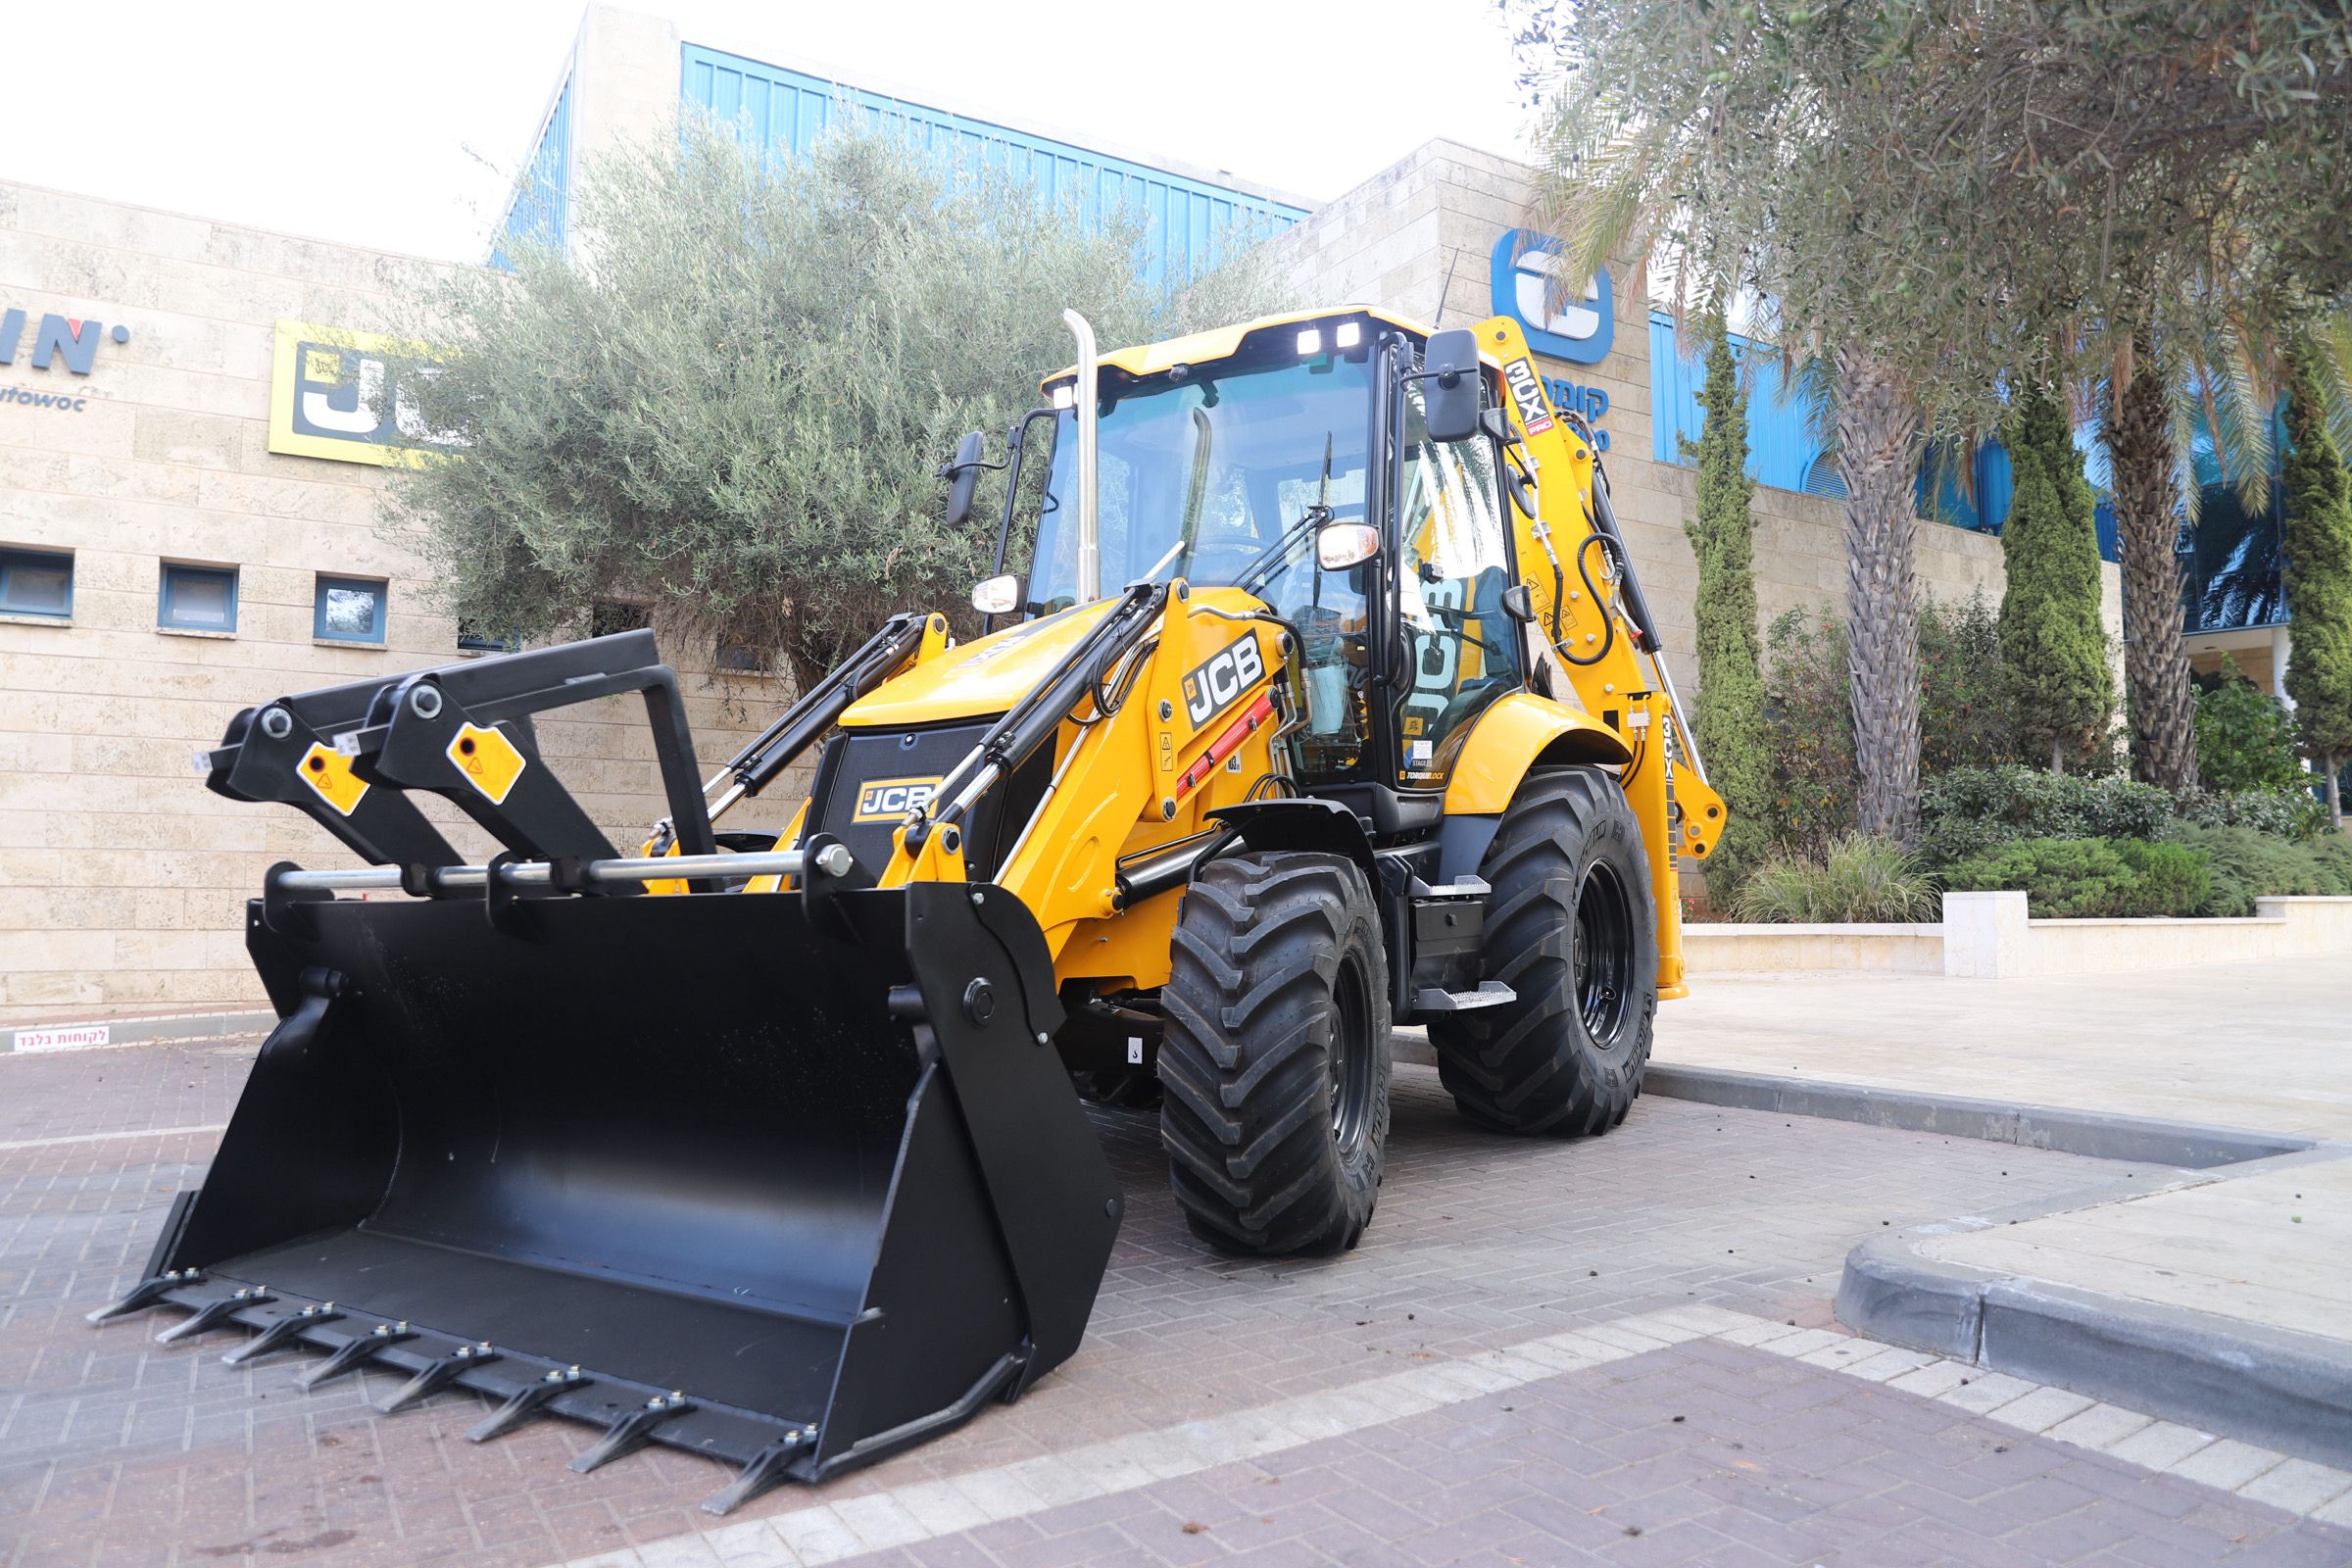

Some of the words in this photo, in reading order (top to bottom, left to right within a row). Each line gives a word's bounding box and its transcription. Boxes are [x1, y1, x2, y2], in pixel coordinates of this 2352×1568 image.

[303, 357, 484, 449] JC
[1504, 359, 1548, 422] 3CX
[1528, 419, 1553, 436] PRO
[1190, 635, 1263, 723] JCB
[1662, 715, 1674, 779] 3CX
[861, 786, 933, 813] JCB
[20, 1034, 52, 1047] בלבד
[57, 1030, 106, 1044] לקוחות
